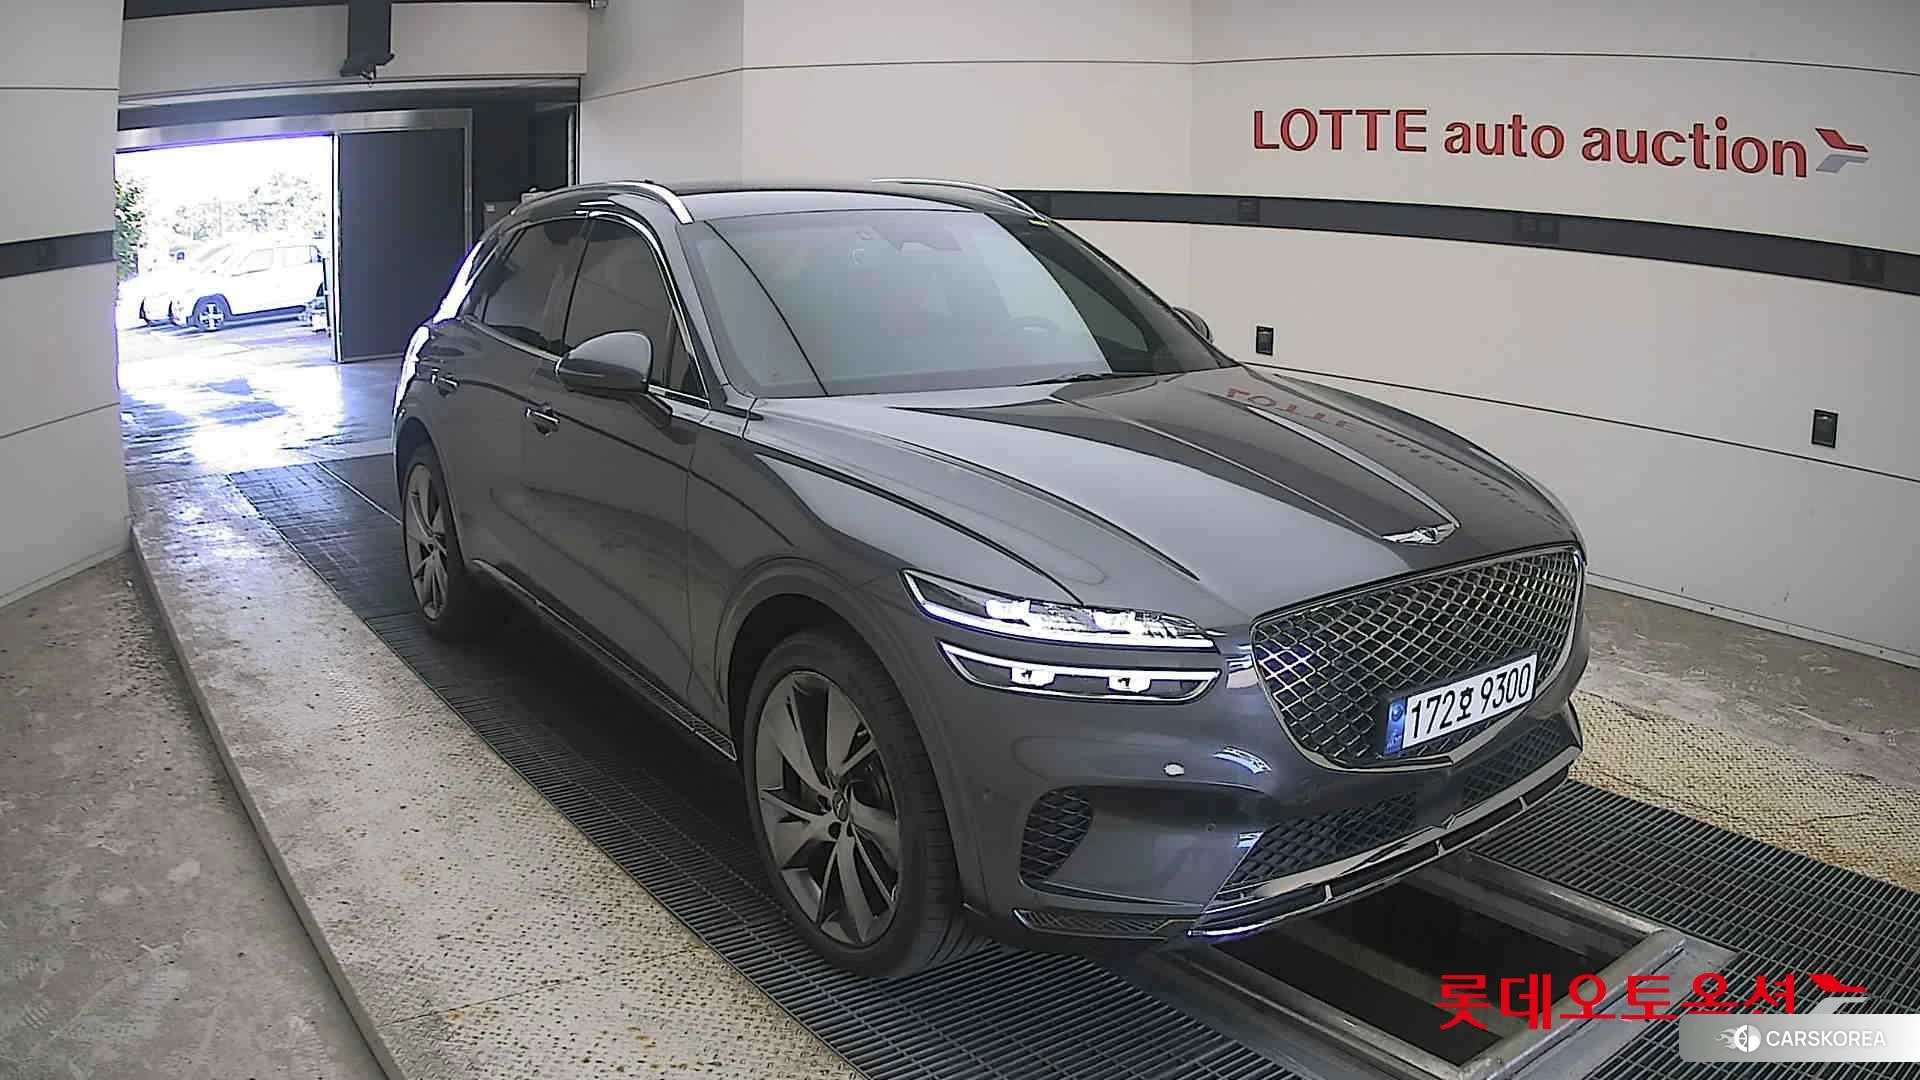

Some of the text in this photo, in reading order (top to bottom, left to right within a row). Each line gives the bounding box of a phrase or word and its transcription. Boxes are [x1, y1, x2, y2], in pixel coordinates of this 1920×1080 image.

[1253, 108, 1808, 178] LOTTE auto auction
[1411, 663, 1532, 739] 172호 9300
